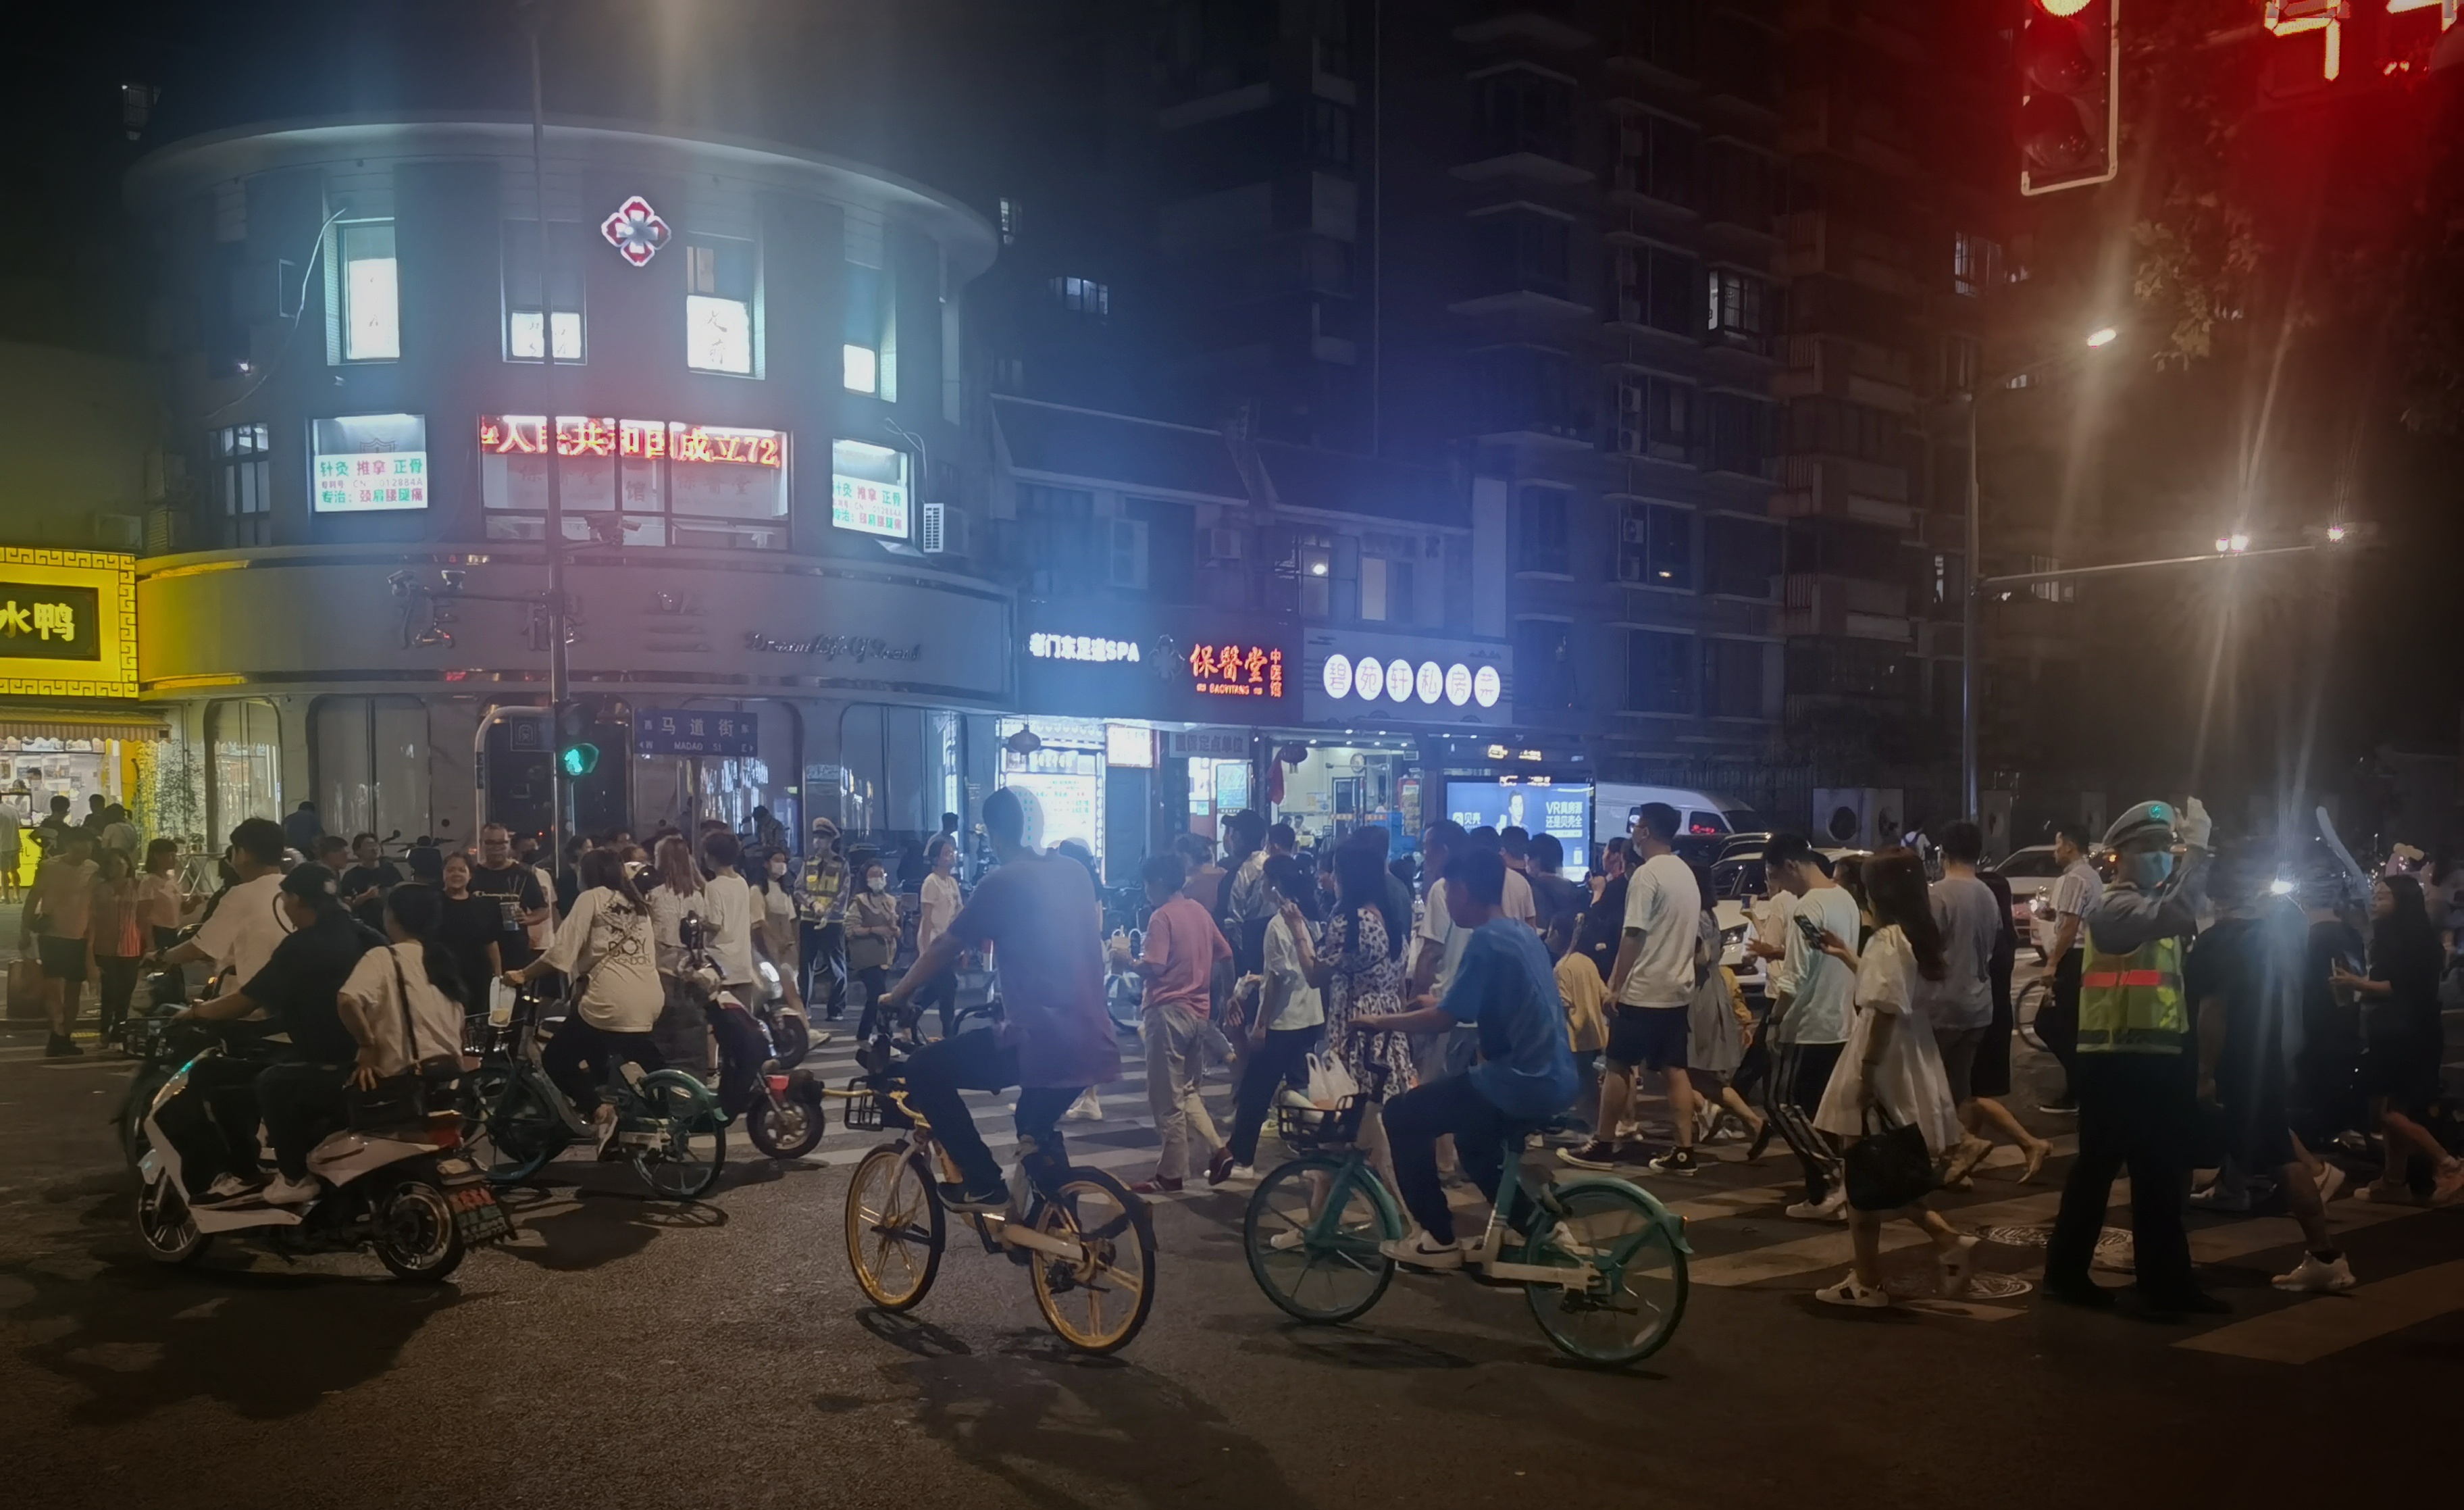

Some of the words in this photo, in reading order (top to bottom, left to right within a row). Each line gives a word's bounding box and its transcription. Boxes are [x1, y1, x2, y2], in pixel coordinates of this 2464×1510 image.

[394, 458, 422, 474] 正骨
[1189, 643, 1268, 683] 保醫堂
[1270, 648, 1282, 697] 中医馆
[1327, 659, 1496, 701] 碧苑轩私房菜
[661, 717, 734, 737] 马道街
[674, 740, 703, 751] MADAO
[1464, 812, 1481, 825] 贝壳
[609, 936, 646, 957] BOY
